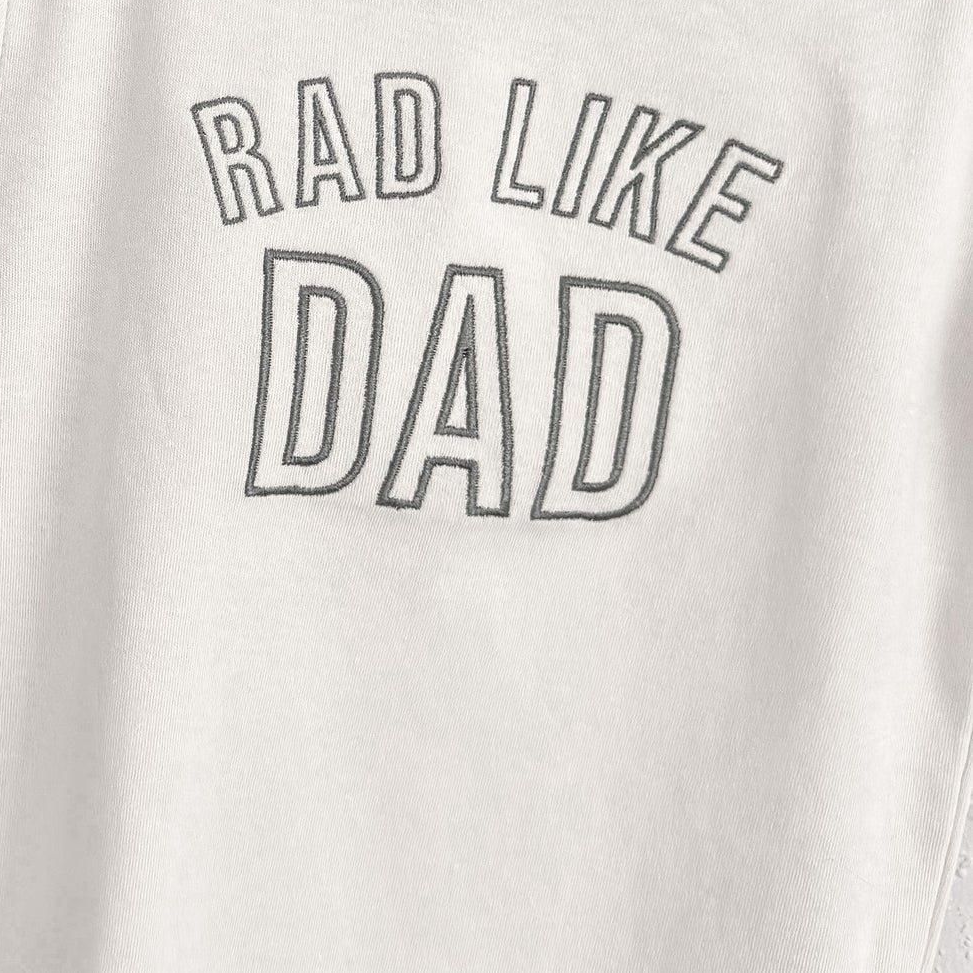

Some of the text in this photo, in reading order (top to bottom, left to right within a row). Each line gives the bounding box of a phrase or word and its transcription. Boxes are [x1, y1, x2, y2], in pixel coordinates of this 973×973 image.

[190, 71, 784, 273] RAD LIKE
[245, 247, 682, 521] DAD
